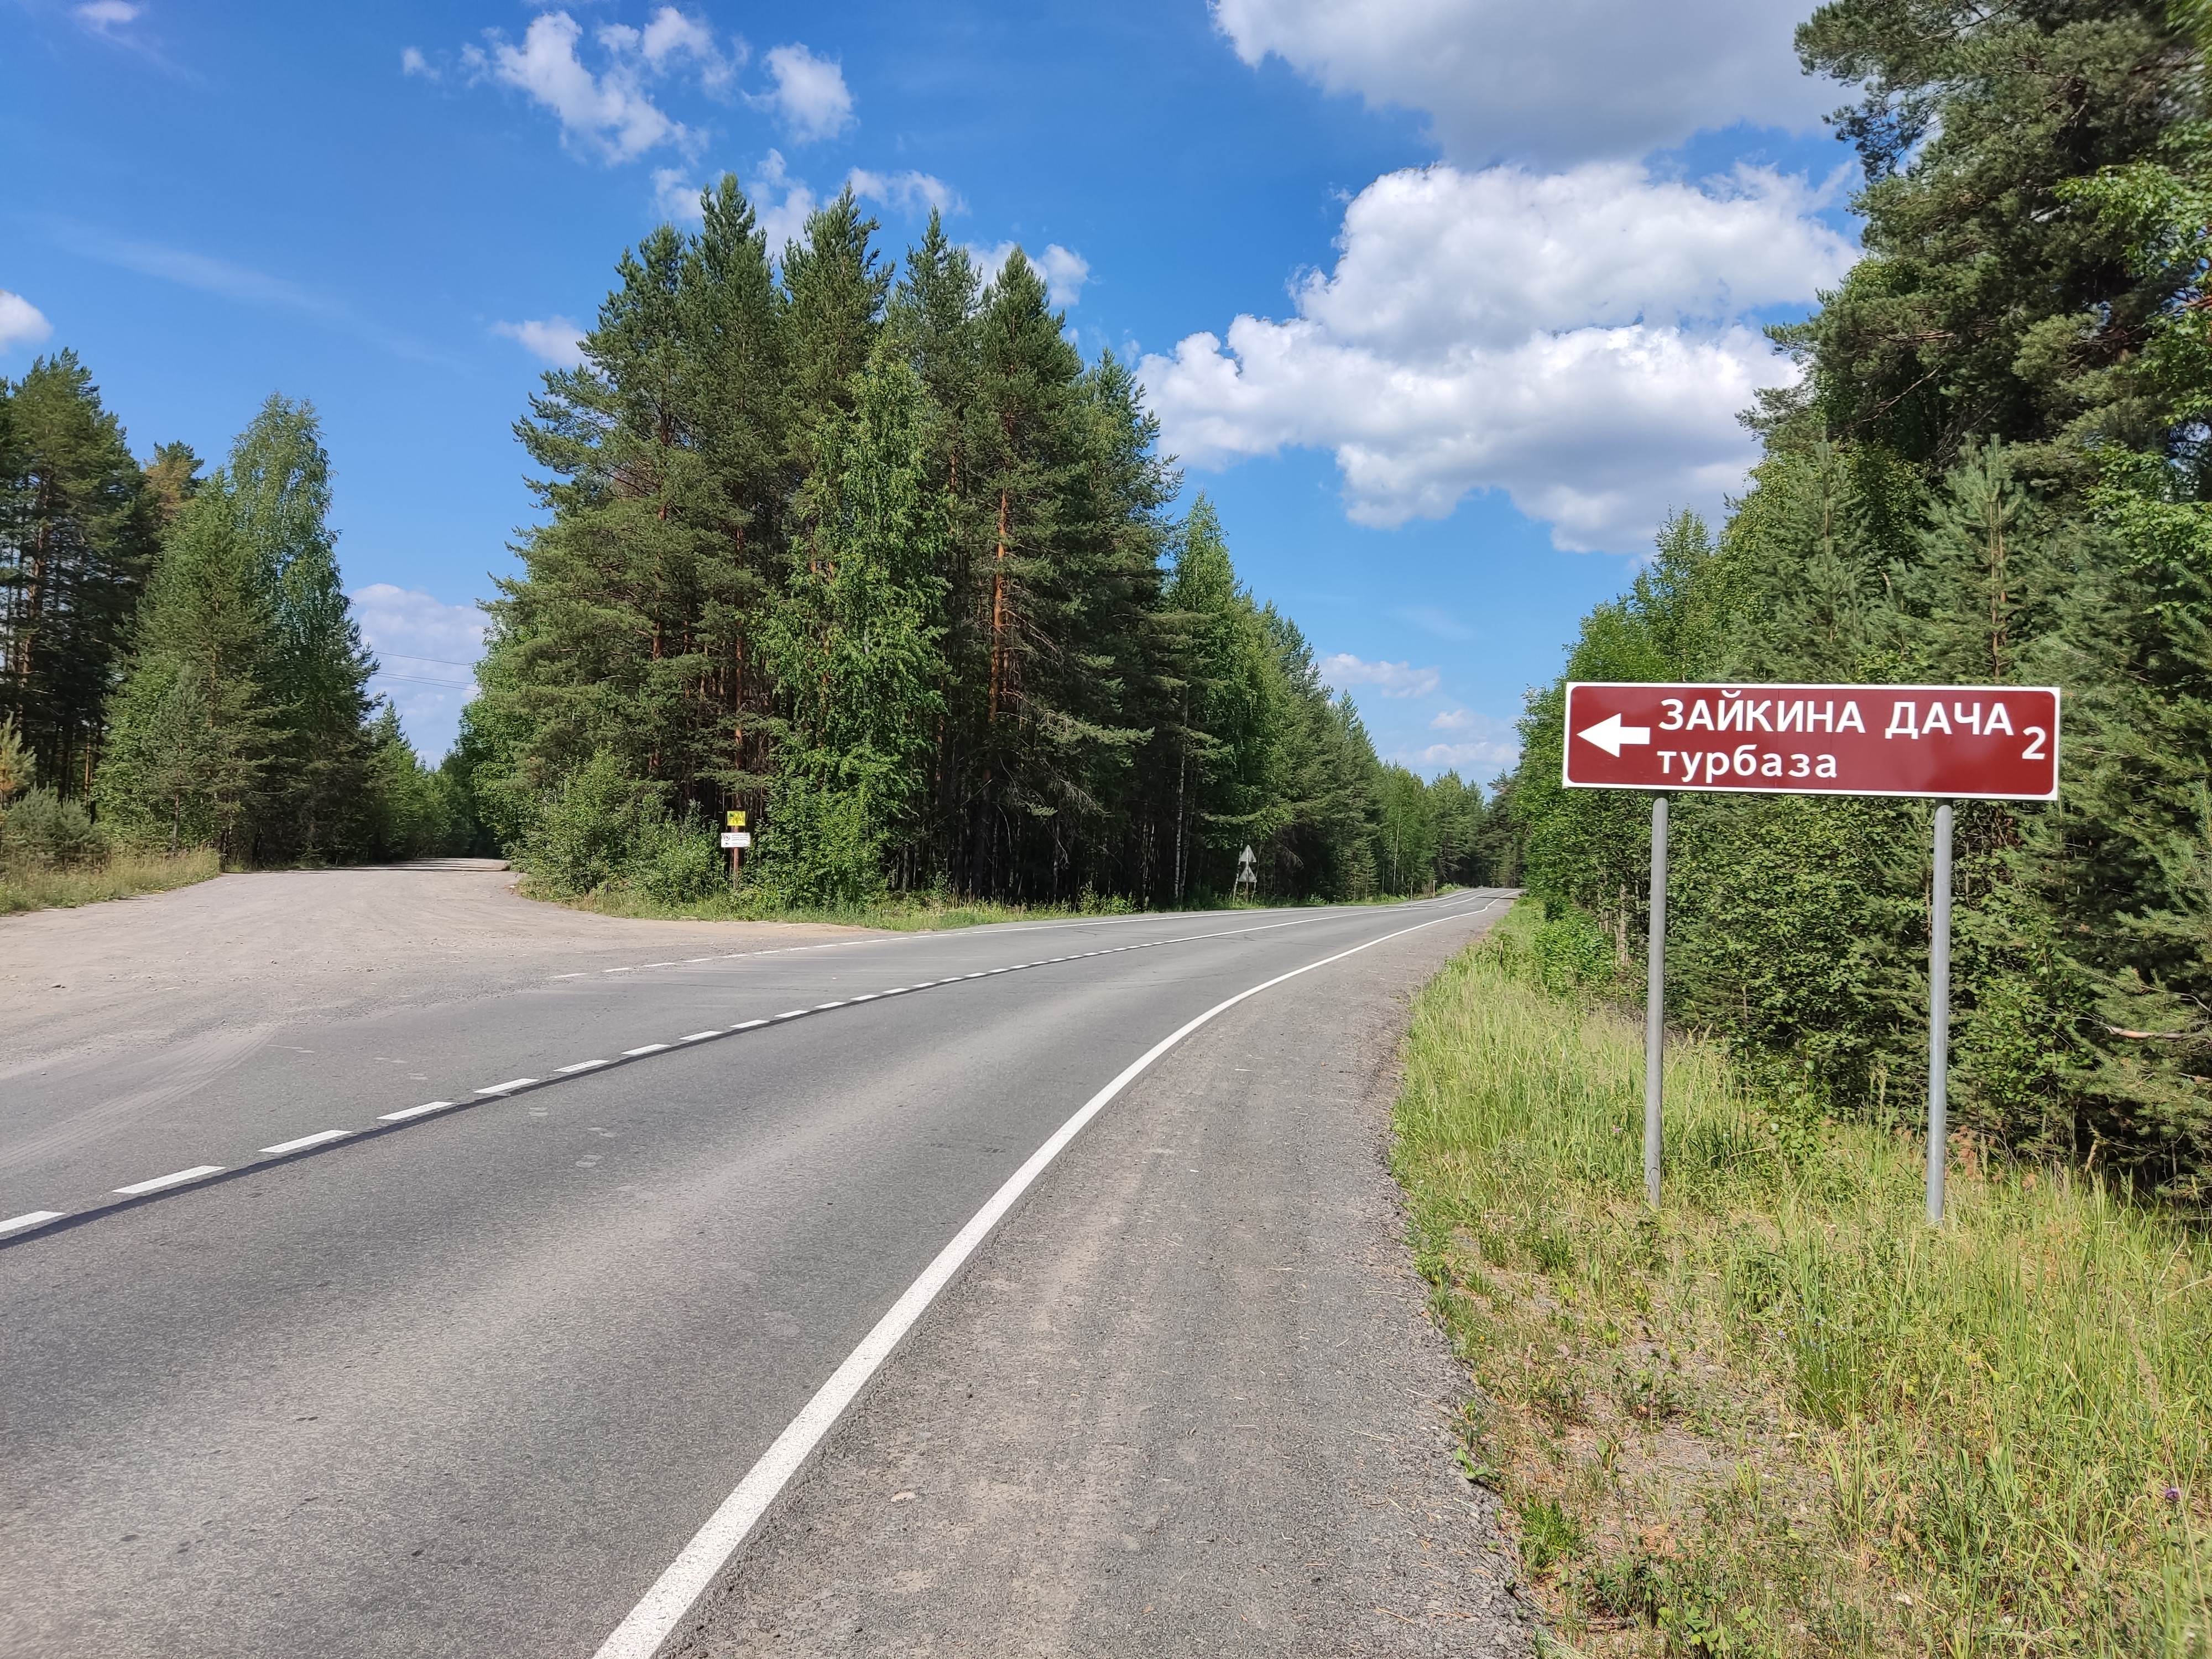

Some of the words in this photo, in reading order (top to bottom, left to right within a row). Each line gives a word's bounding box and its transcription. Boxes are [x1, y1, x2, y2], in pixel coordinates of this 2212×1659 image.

[1657, 689, 1866, 734] ЗАЙКИНА
[1885, 701, 2015, 740] ДАЧА
[1656, 743, 1838, 784] турбаза
[2021, 726, 2047, 760] 2
